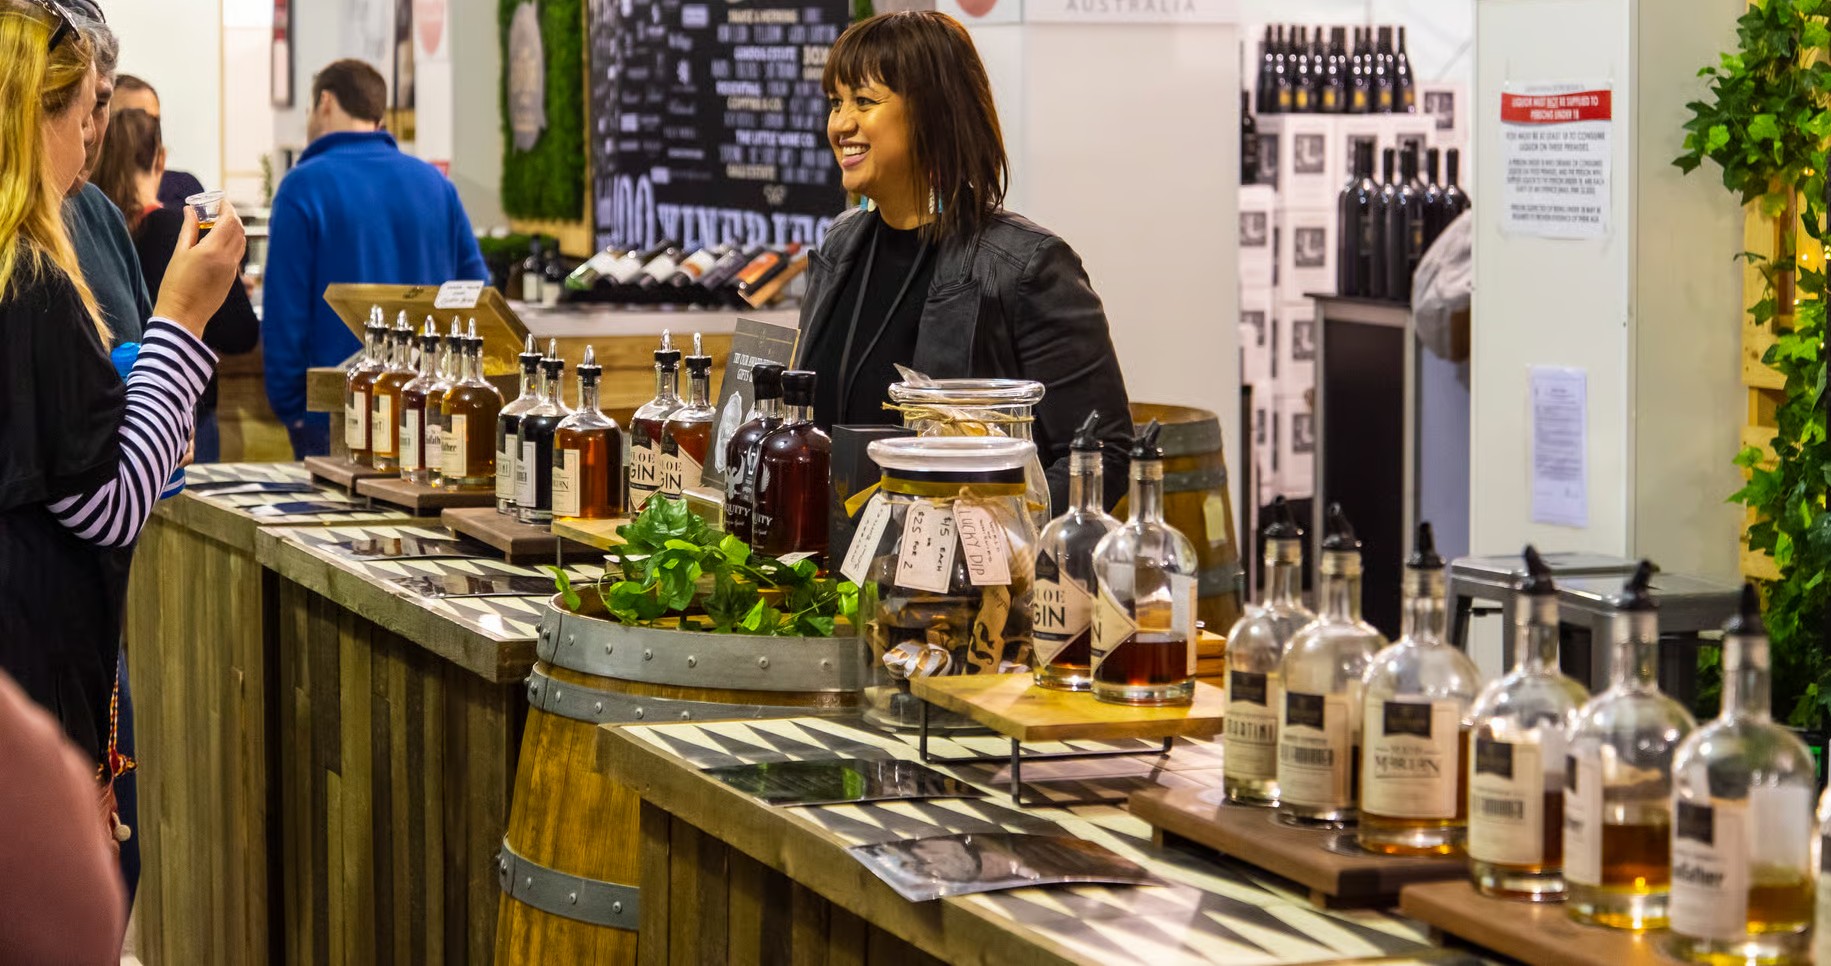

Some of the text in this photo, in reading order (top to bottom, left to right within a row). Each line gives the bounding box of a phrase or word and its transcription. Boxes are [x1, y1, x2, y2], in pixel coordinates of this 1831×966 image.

[1066, 0, 1196, 12] AUSTRALIA
[1591, 95, 1599, 106] TO
[630, 462, 655, 481] GIN
[911, 511, 925, 534] $25
[936, 516, 953, 571] $15 EACH
[958, 510, 985, 576] LUCKY DIP
[903, 560, 914, 570] 2
[1033, 603, 1065, 628] GIN
